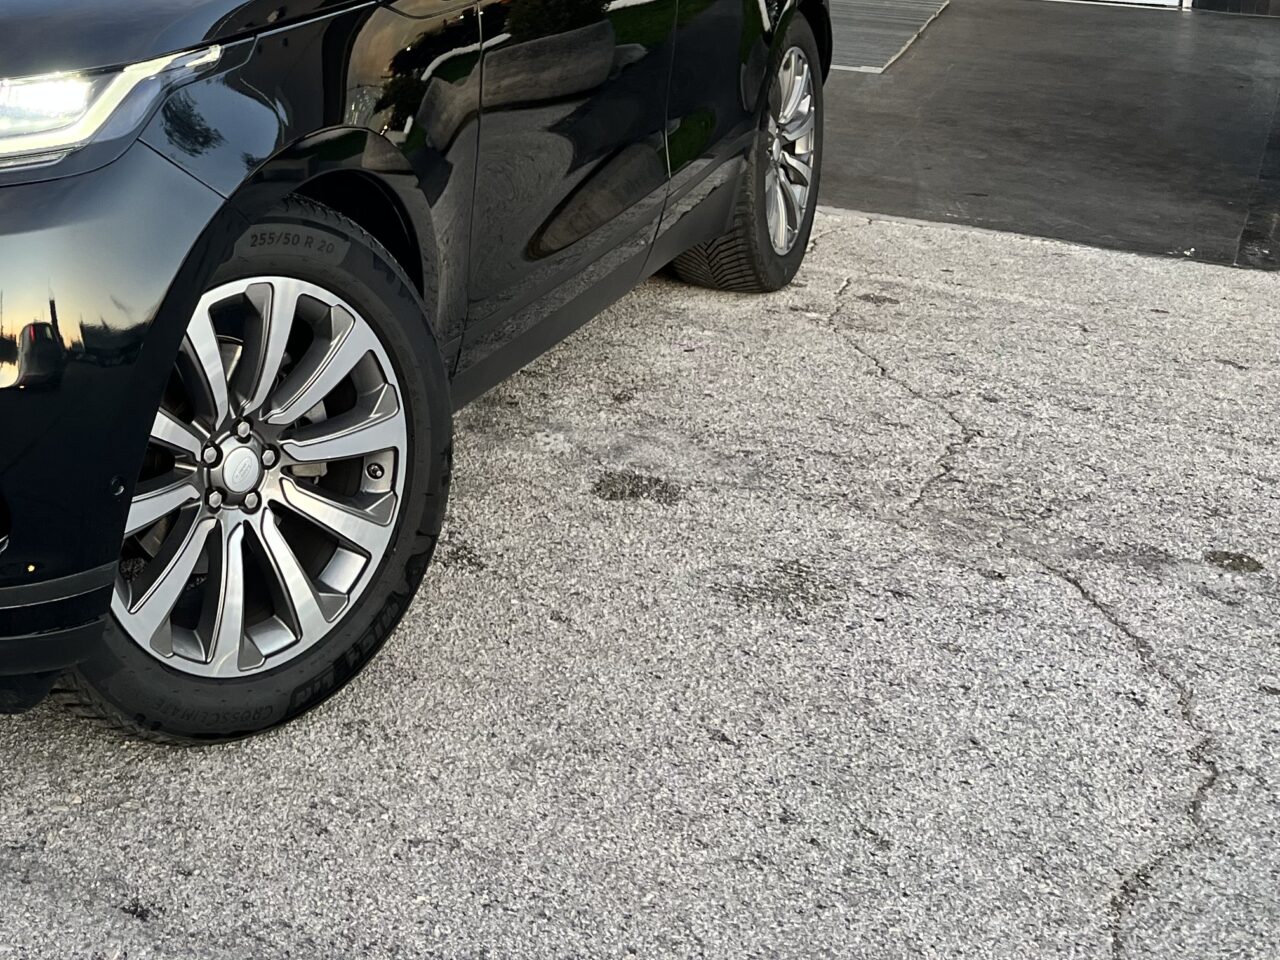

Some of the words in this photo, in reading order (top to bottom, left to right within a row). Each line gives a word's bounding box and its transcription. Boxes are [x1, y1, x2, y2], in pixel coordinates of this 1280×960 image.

[249, 232, 300, 248] 255/50
[304, 235, 314, 248] R
[317, 240, 335, 254] 20
